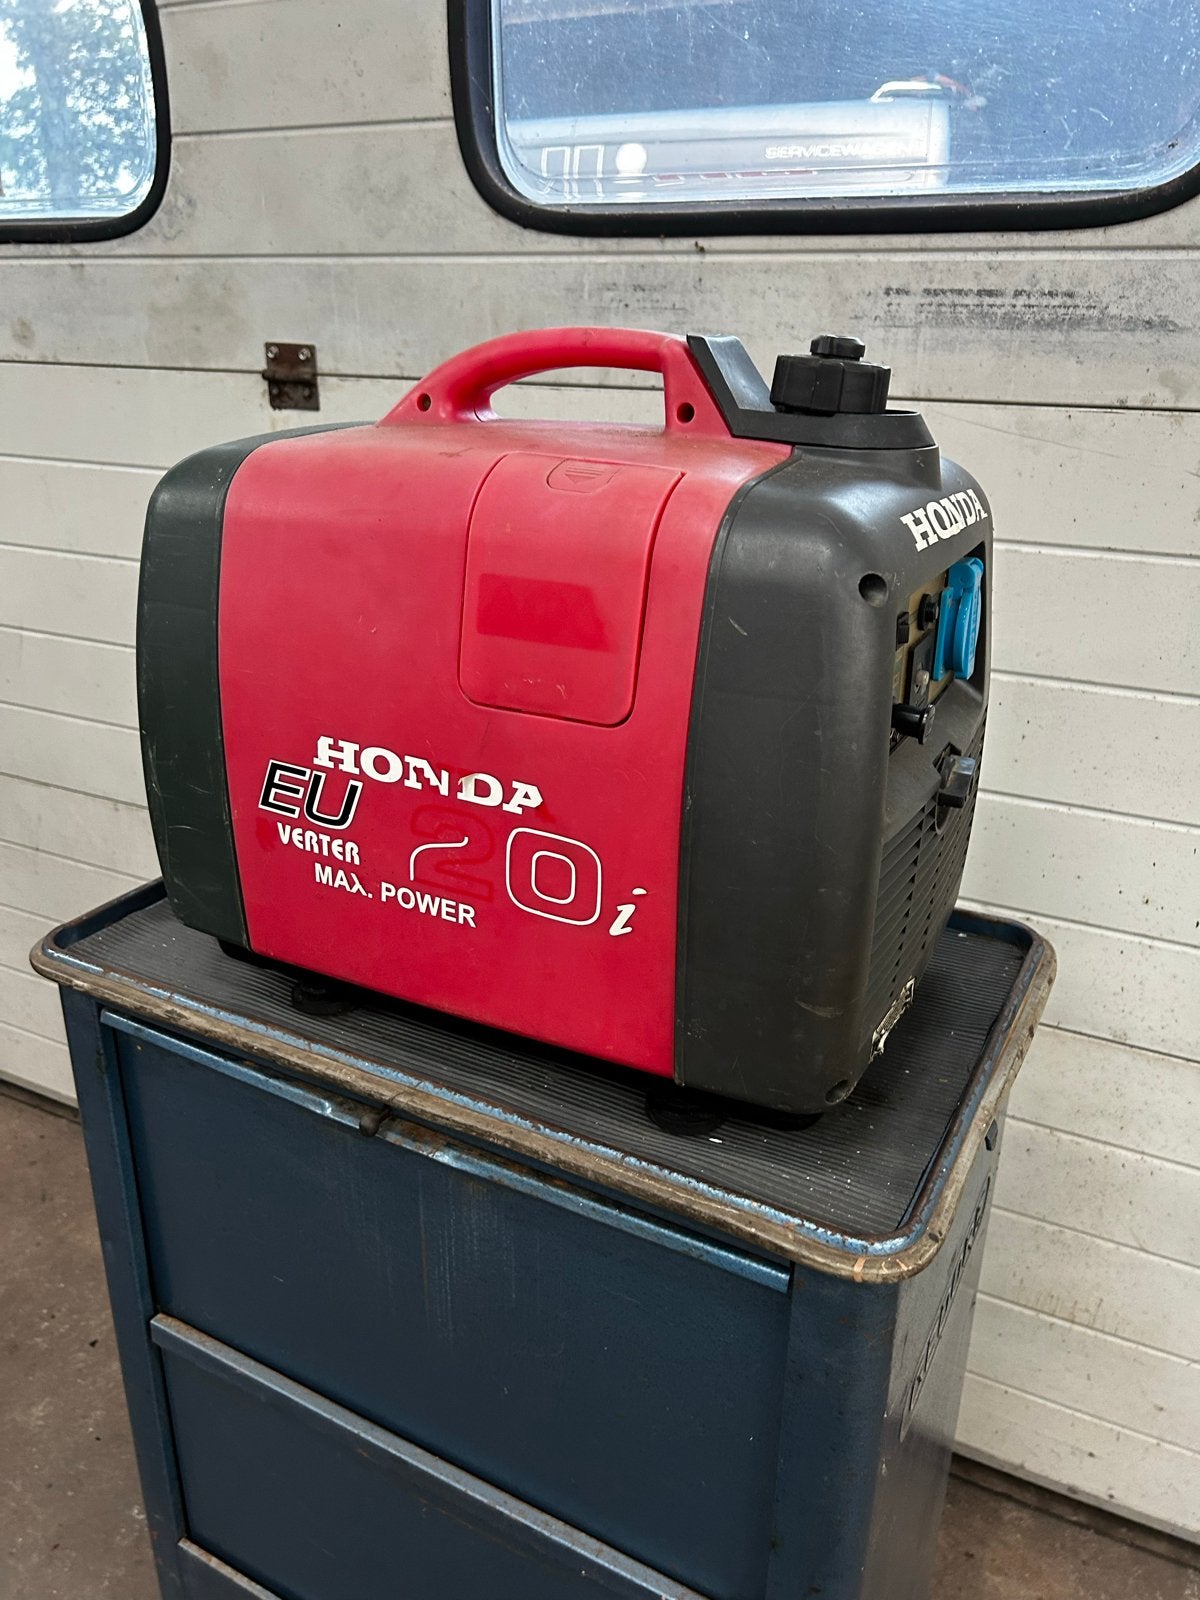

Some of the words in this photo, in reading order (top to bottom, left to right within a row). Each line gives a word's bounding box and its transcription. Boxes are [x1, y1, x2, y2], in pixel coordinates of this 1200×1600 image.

[901, 489, 988, 551] HONDA
[258, 760, 363, 830] EU
[313, 736, 543, 815] HONDA
[276, 822, 361, 865] VERTER
[381, 882, 476, 928] POWER
